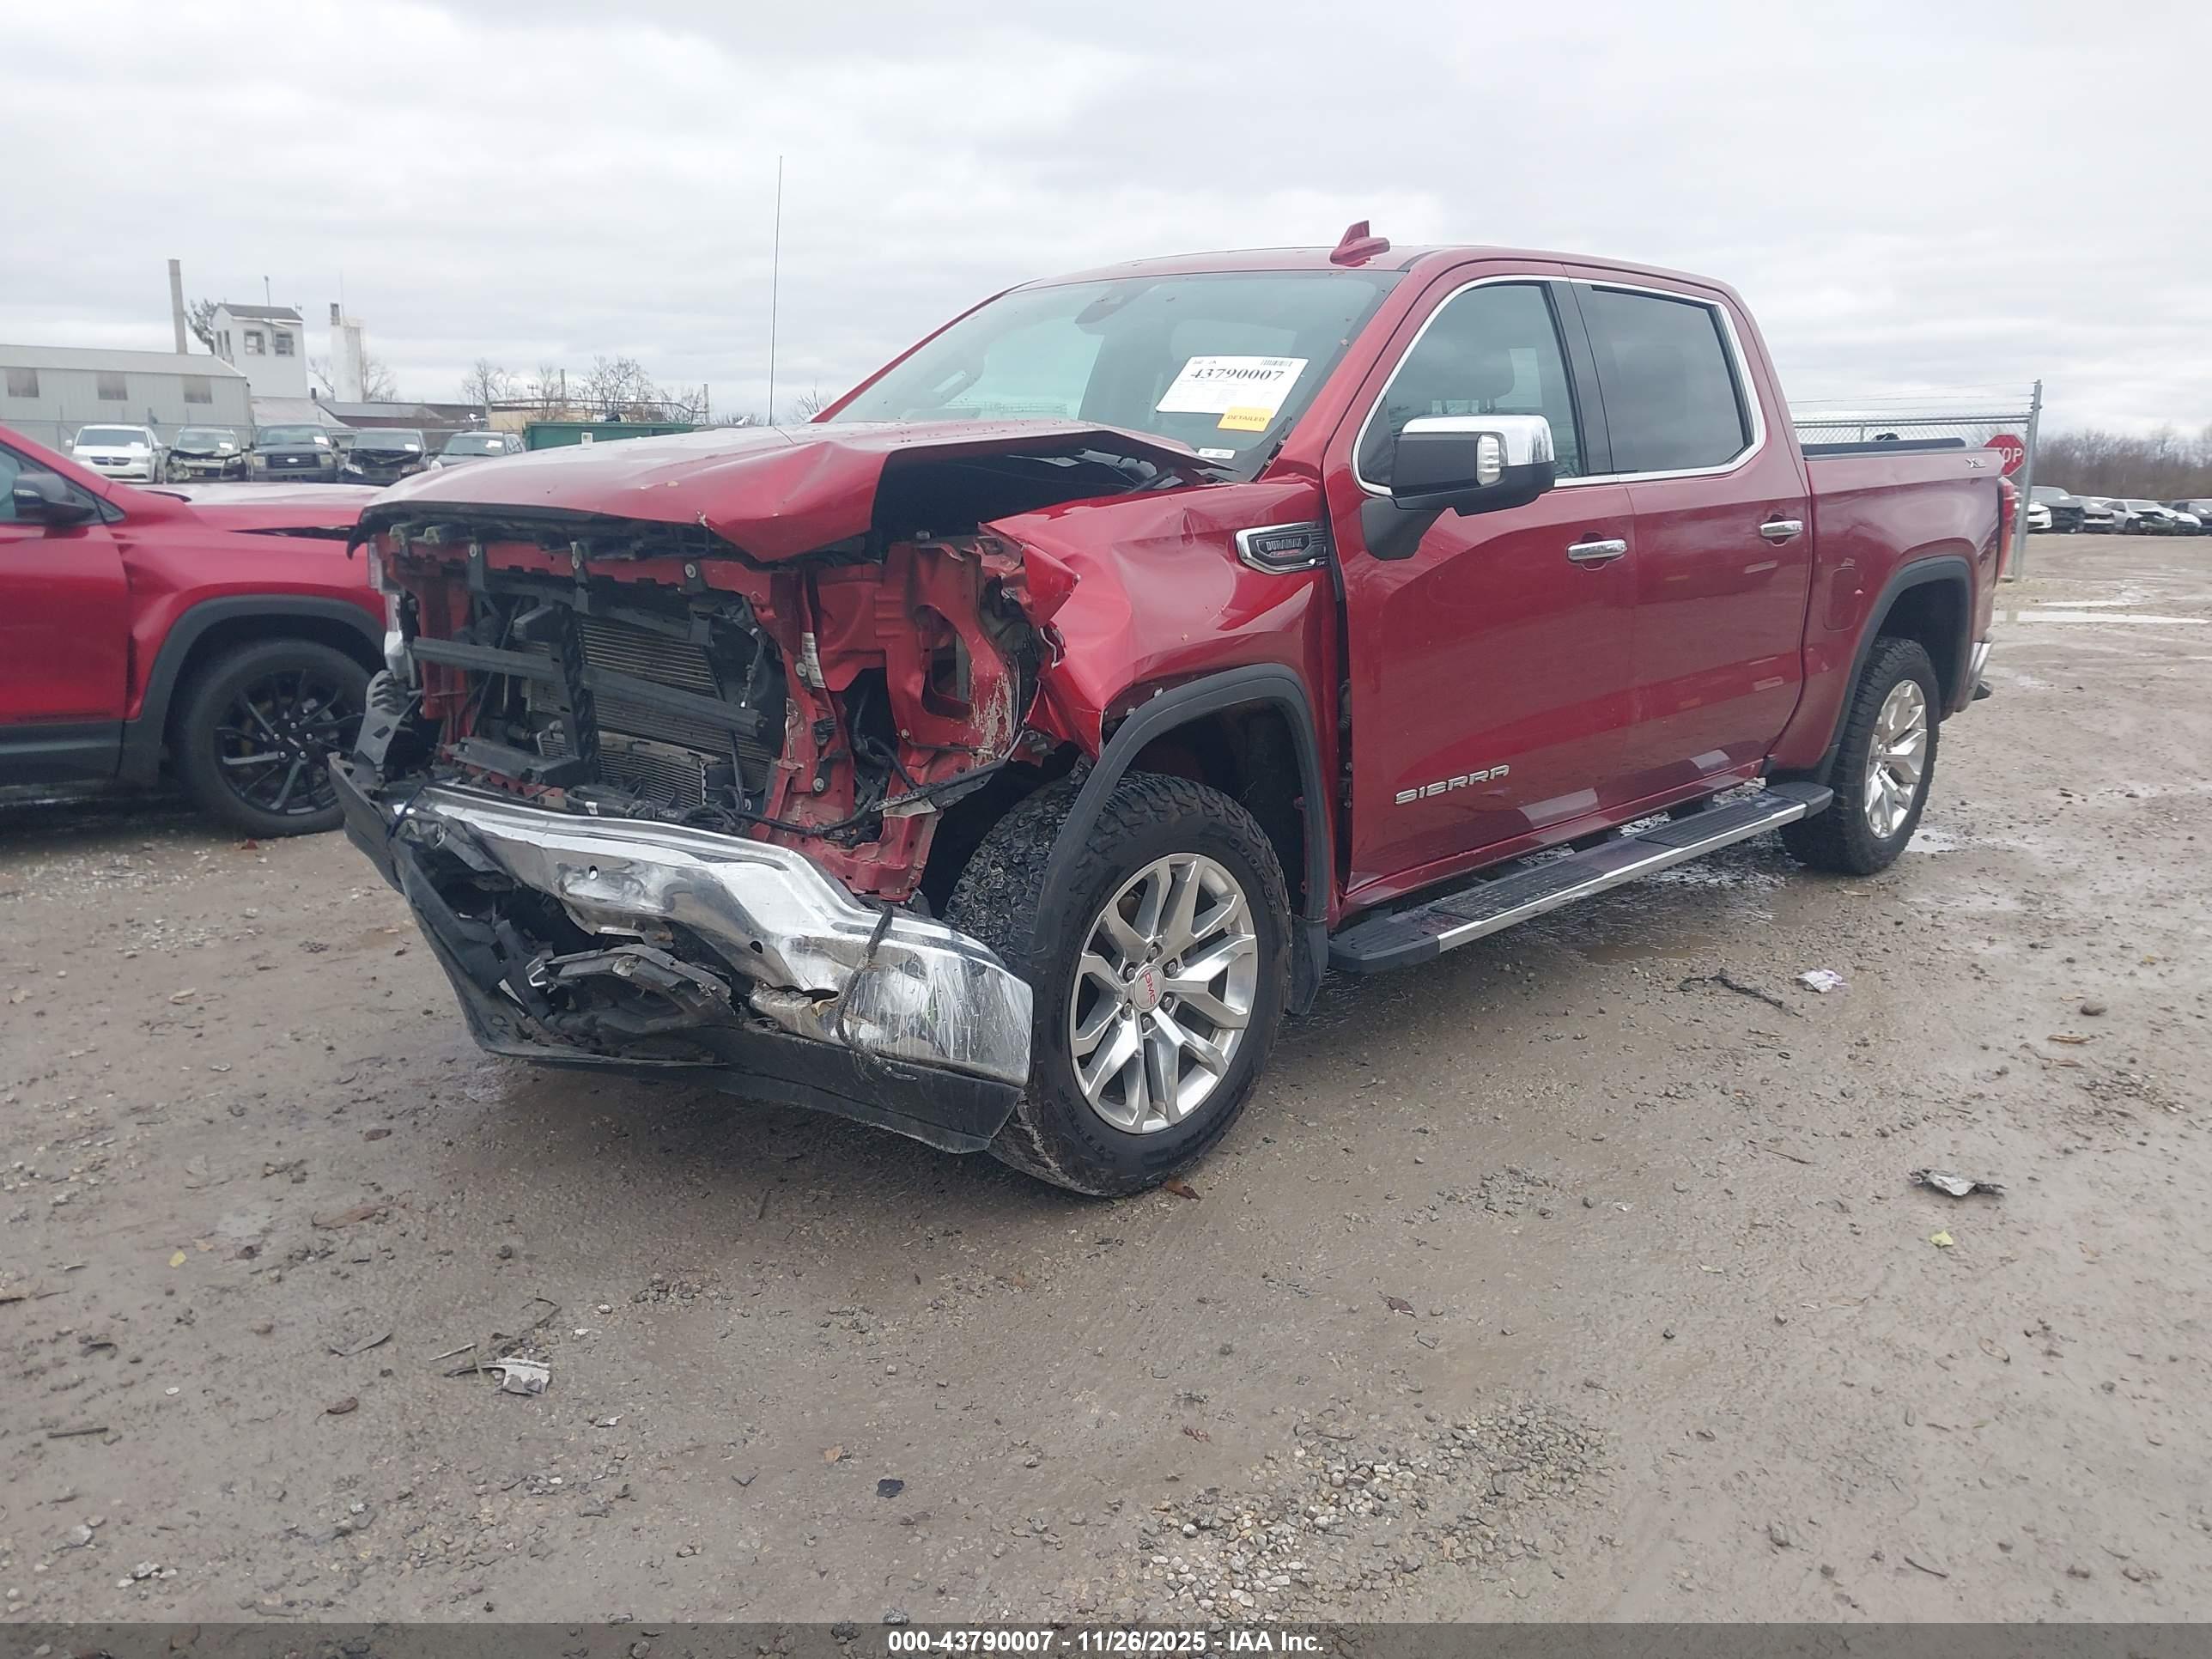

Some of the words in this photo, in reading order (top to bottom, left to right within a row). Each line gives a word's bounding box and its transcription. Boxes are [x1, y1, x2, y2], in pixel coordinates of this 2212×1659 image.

[1190, 368, 1285, 382] 43790007
[1226, 414, 1266, 423] DETAILED
[2001, 447, 2023, 463] OP
[1395, 763, 1510, 805] SIERRA
[1144, 971, 1157, 1005] GMC
